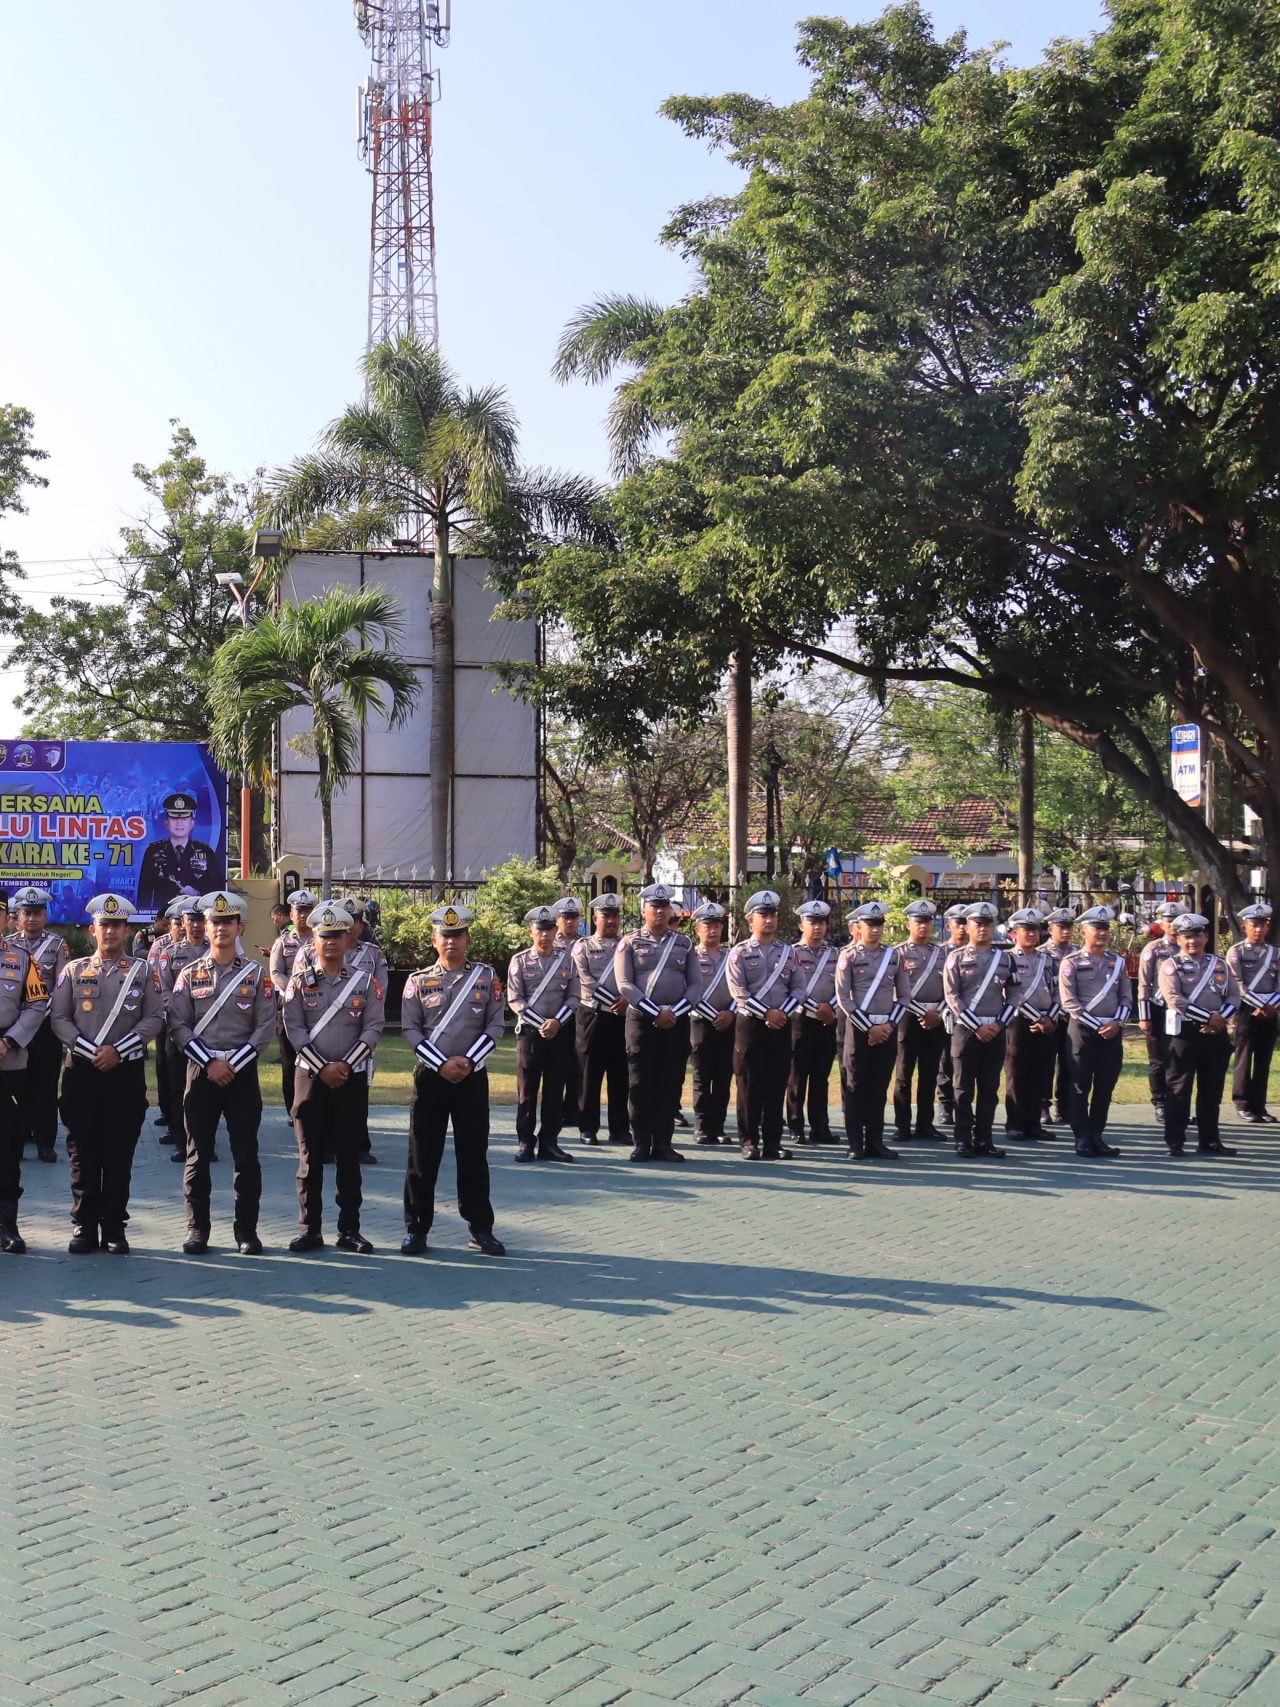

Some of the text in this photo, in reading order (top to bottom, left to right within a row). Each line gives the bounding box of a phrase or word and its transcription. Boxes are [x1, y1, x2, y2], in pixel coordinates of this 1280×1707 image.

[1177, 764, 1196, 775] ATM
[40, 816, 145, 839] LINTAS
[61, 842, 90, 865] KE
[108, 843, 133, 866] 71
[0, 870, 31, 878] Mengabdi
[1, 963, 21, 971] POLRI
